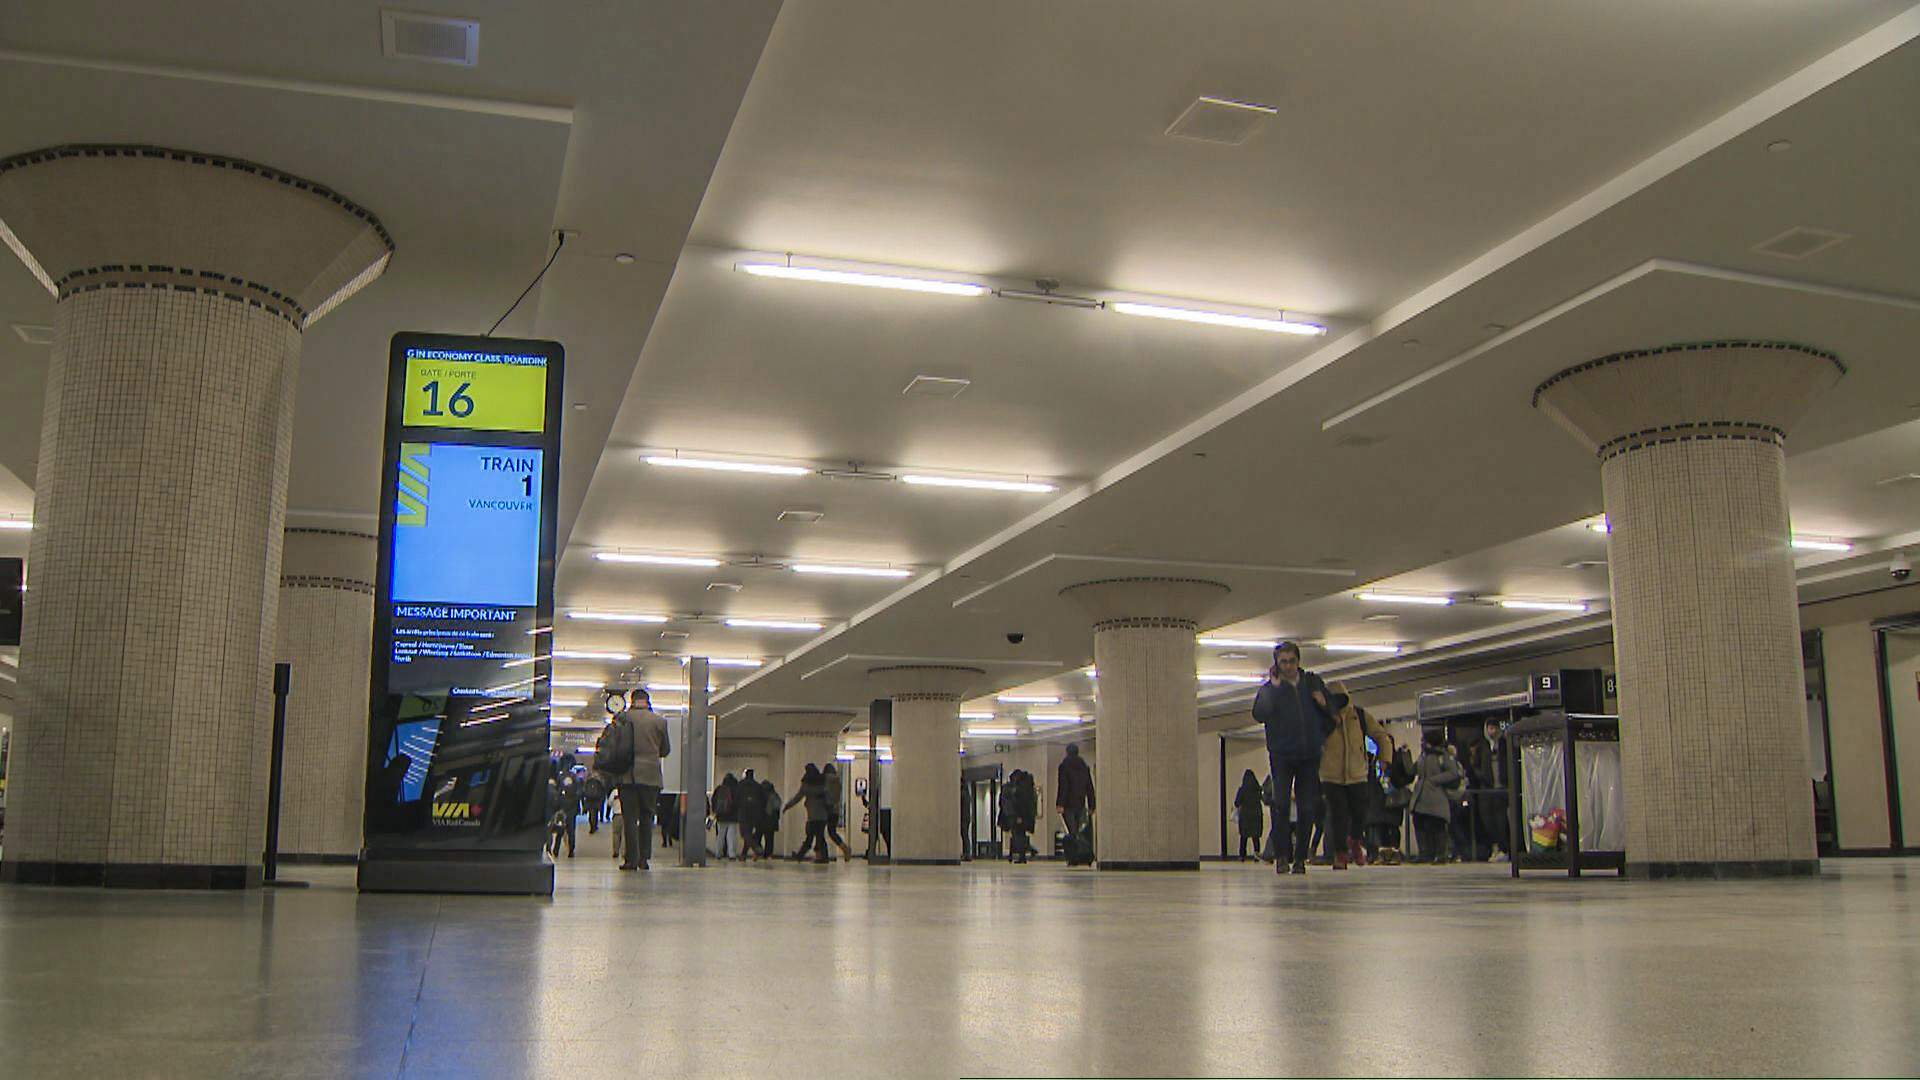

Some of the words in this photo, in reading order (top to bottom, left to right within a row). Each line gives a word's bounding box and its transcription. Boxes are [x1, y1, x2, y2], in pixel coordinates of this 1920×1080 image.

[416, 350, 426, 359] IN
[427, 350, 473, 361] ECONOMY
[421, 369, 441, 377] GATE
[449, 370, 477, 379] PORTE
[422, 380, 475, 418] 16
[480, 457, 534, 472] TRAIN
[522, 475, 532, 496] 1
[468, 499, 532, 510] VANCOUVER
[396, 606, 449, 619] MESSAGE
[450, 608, 517, 621] IMPORTANT
[1542, 677, 1551, 688] 9
